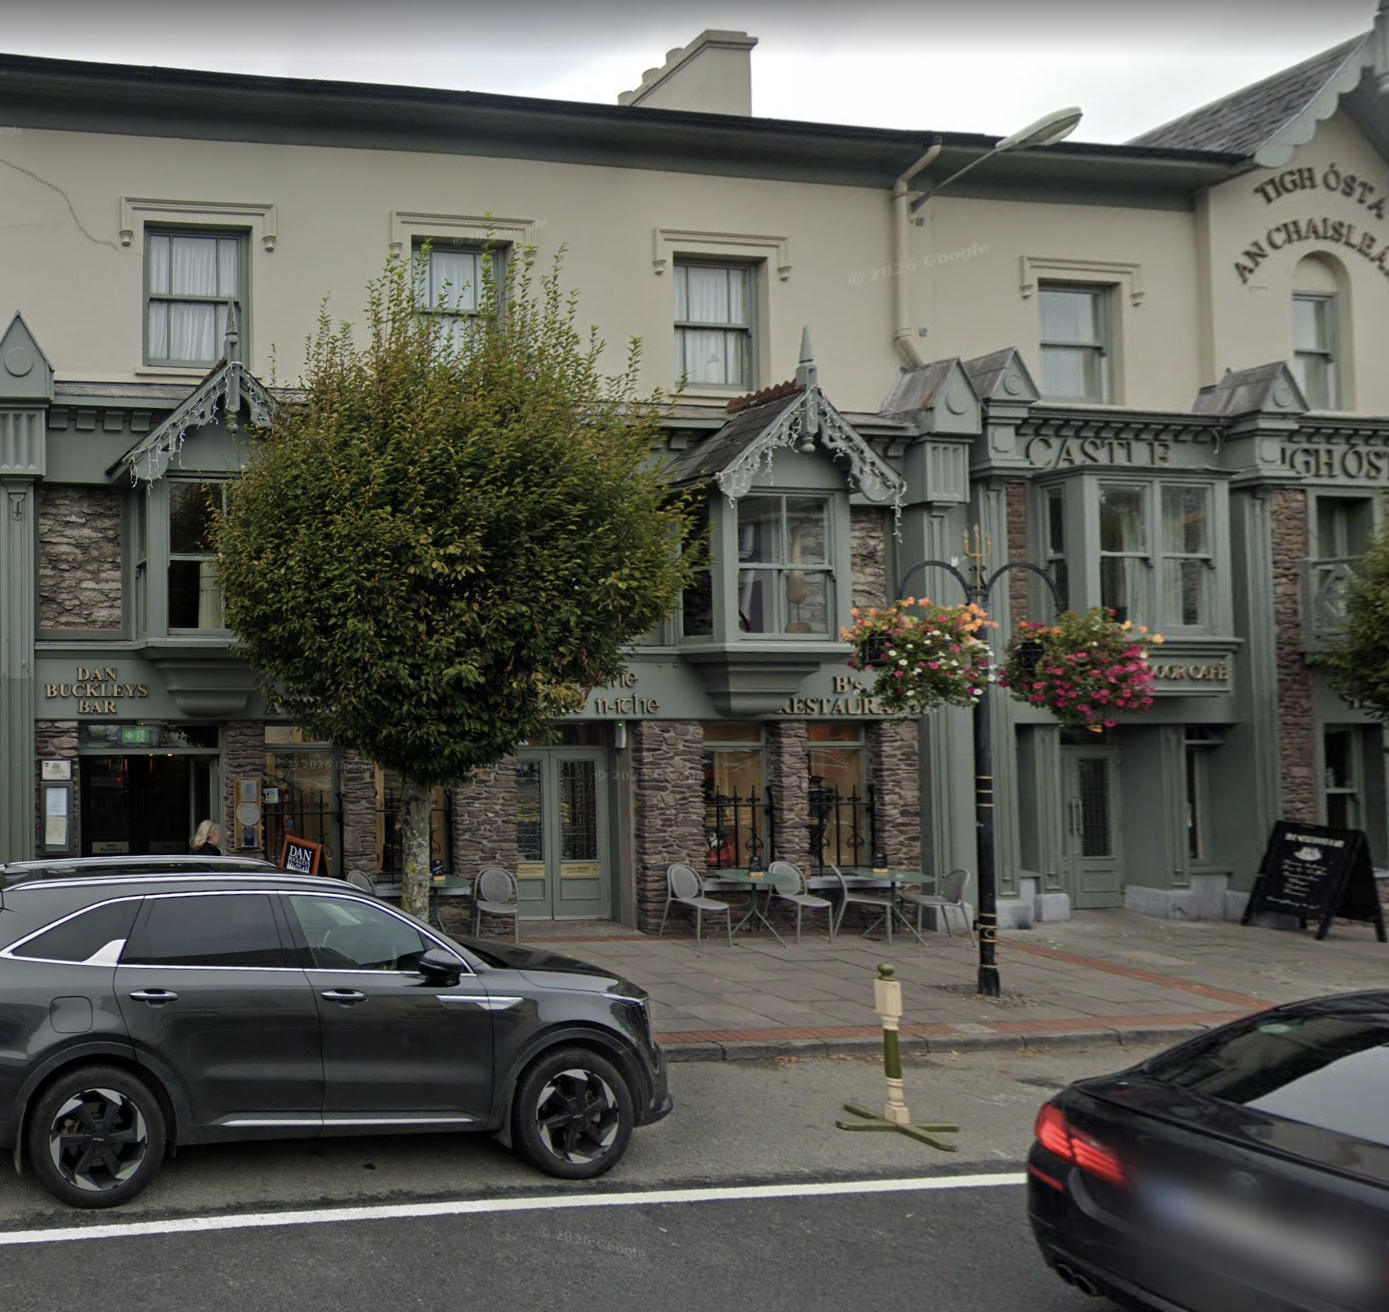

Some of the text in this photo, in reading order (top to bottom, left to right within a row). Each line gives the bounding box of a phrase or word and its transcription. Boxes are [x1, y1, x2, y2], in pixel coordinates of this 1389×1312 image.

[1253, 162, 1387, 220] TIGH ÓSTA
[1234, 239, 1269, 285] AN
[1025, 435, 1170, 470] CASTLE
[76, 666, 117, 682] DAN
[45, 683, 149, 698] BUCKLEYS
[77, 700, 118, 714] BAR
[289, 844, 313, 862] DAN
